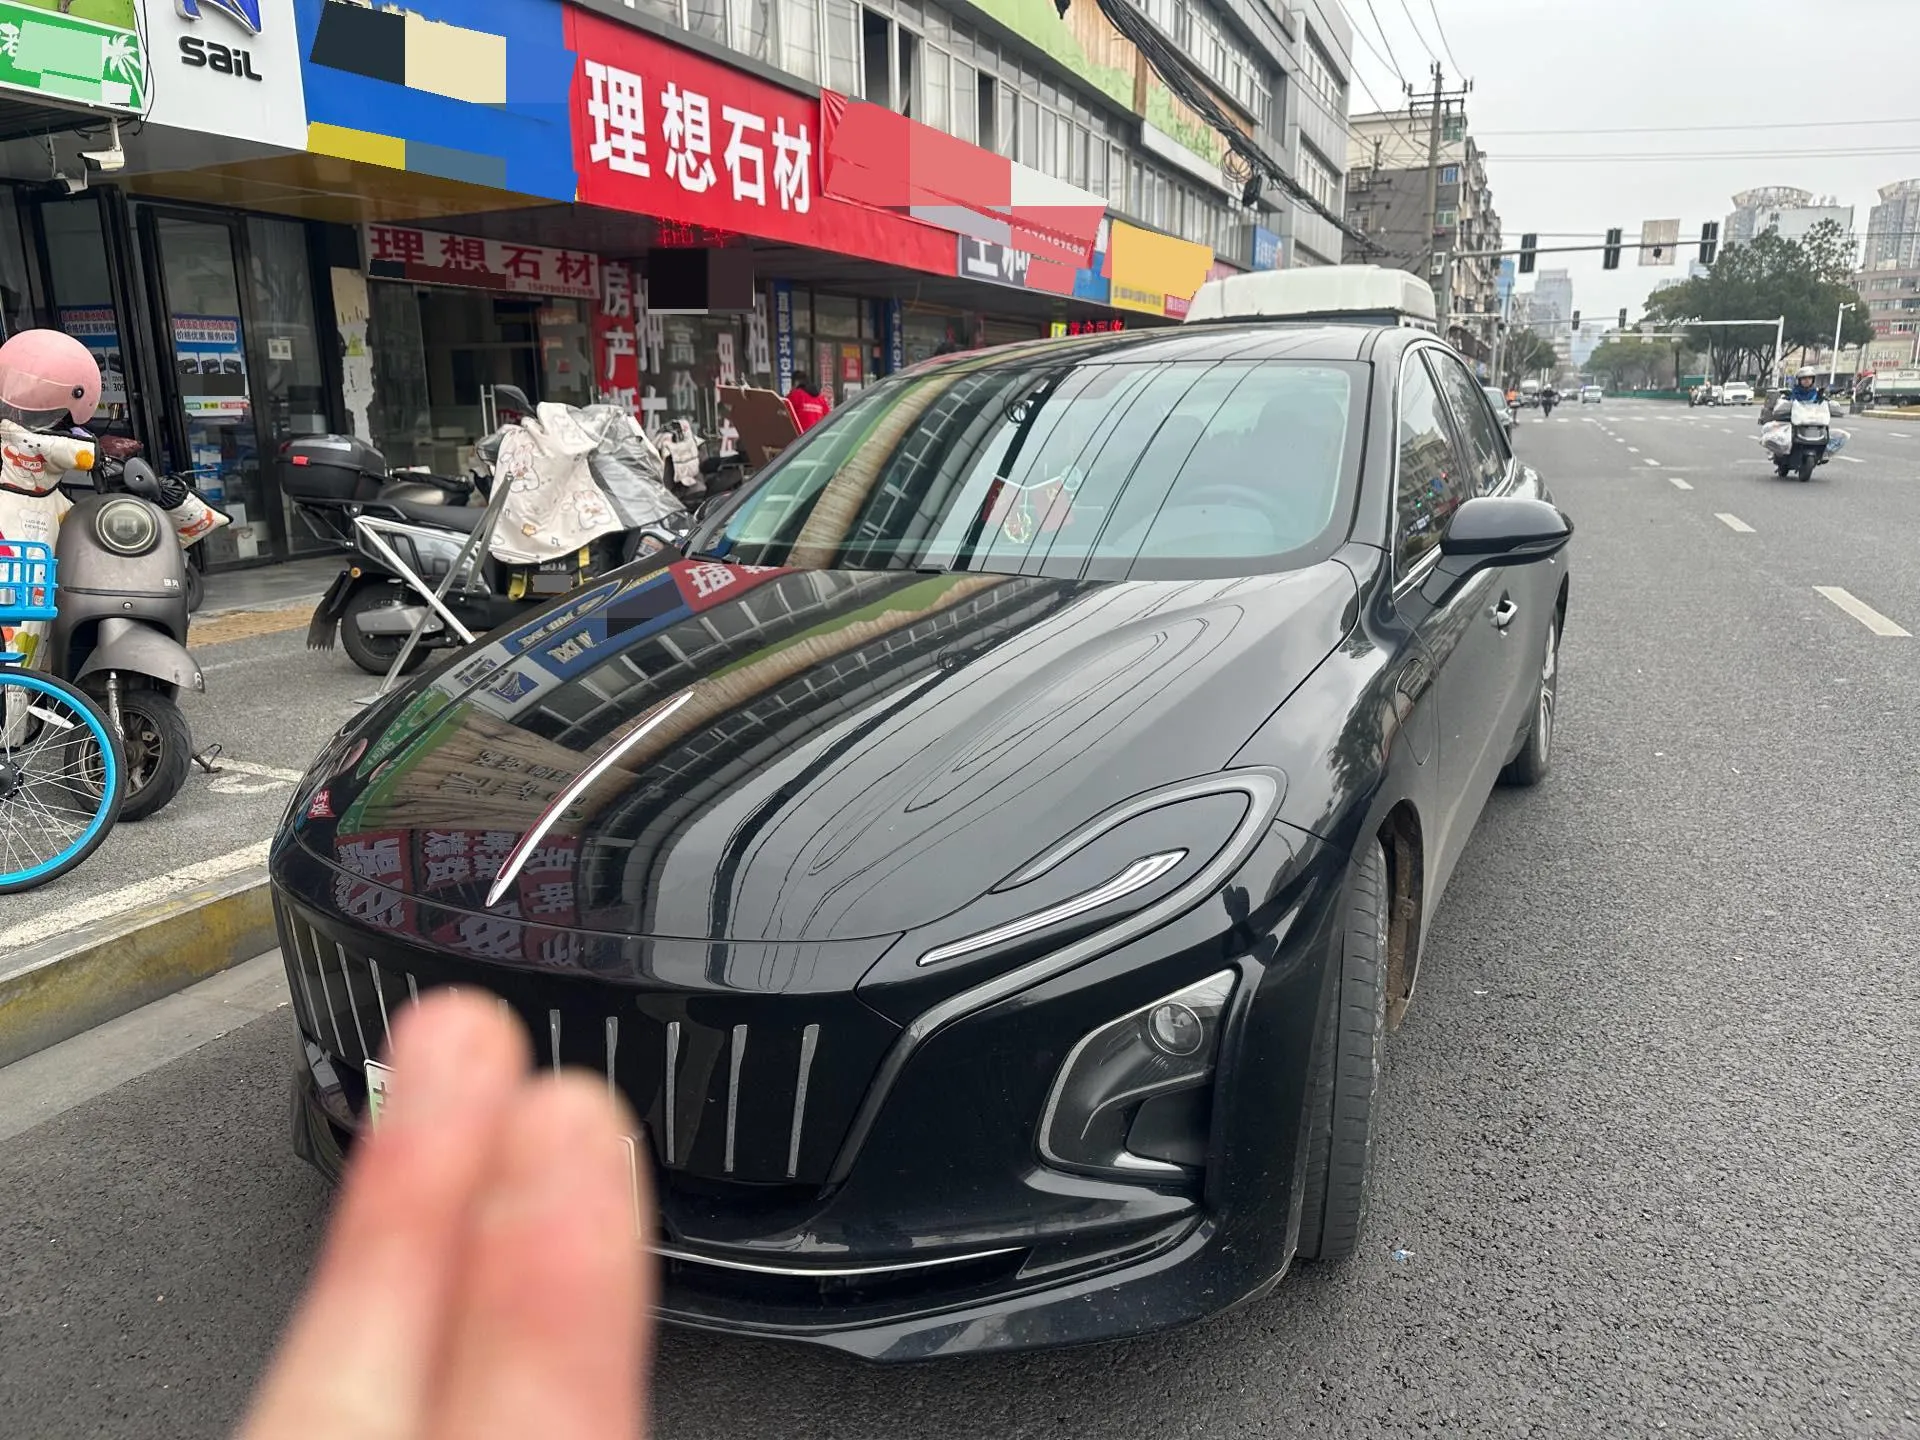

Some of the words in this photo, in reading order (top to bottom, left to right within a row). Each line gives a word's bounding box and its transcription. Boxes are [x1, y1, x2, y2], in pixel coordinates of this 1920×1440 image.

[584, 57, 813, 214] 理想石材
[369, 226, 595, 286] 理想石材
